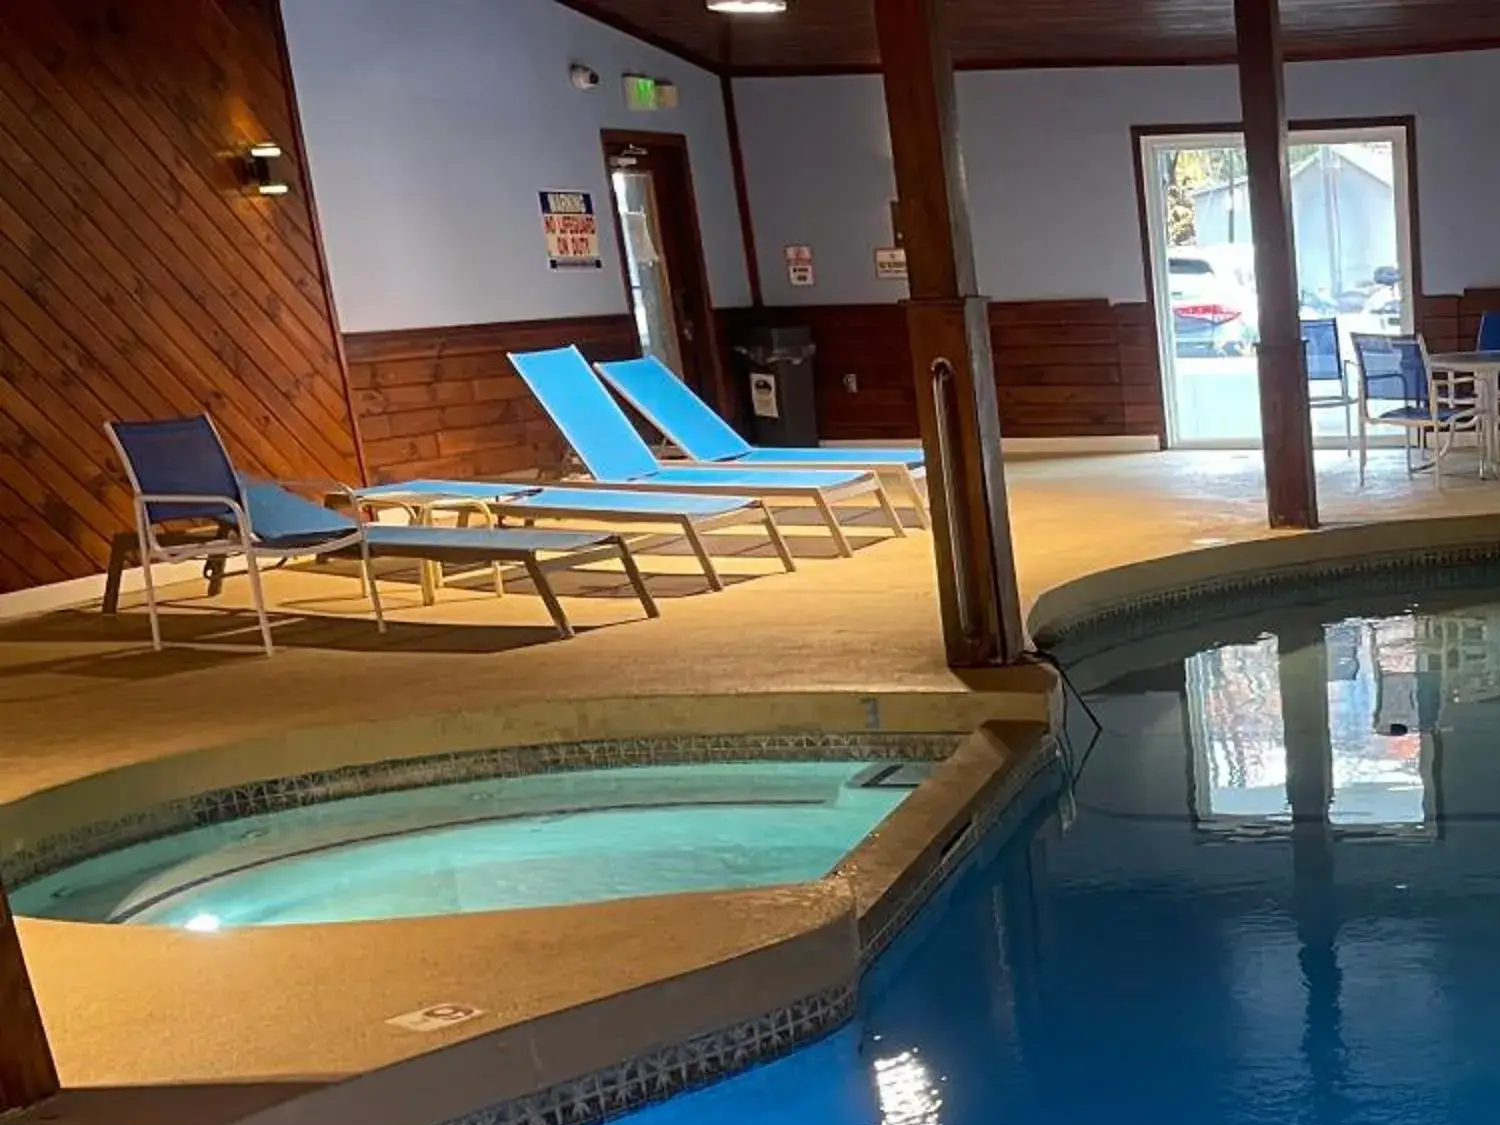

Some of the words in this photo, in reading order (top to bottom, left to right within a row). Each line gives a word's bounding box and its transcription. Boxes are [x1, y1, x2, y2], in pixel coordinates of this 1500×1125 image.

[547, 193, 587, 213] WARNING
[544, 215, 556, 234] NO
[556, 215, 596, 234] LIFEGUARD
[556, 236, 570, 255] ON
[571, 236, 591, 255] DUTY
